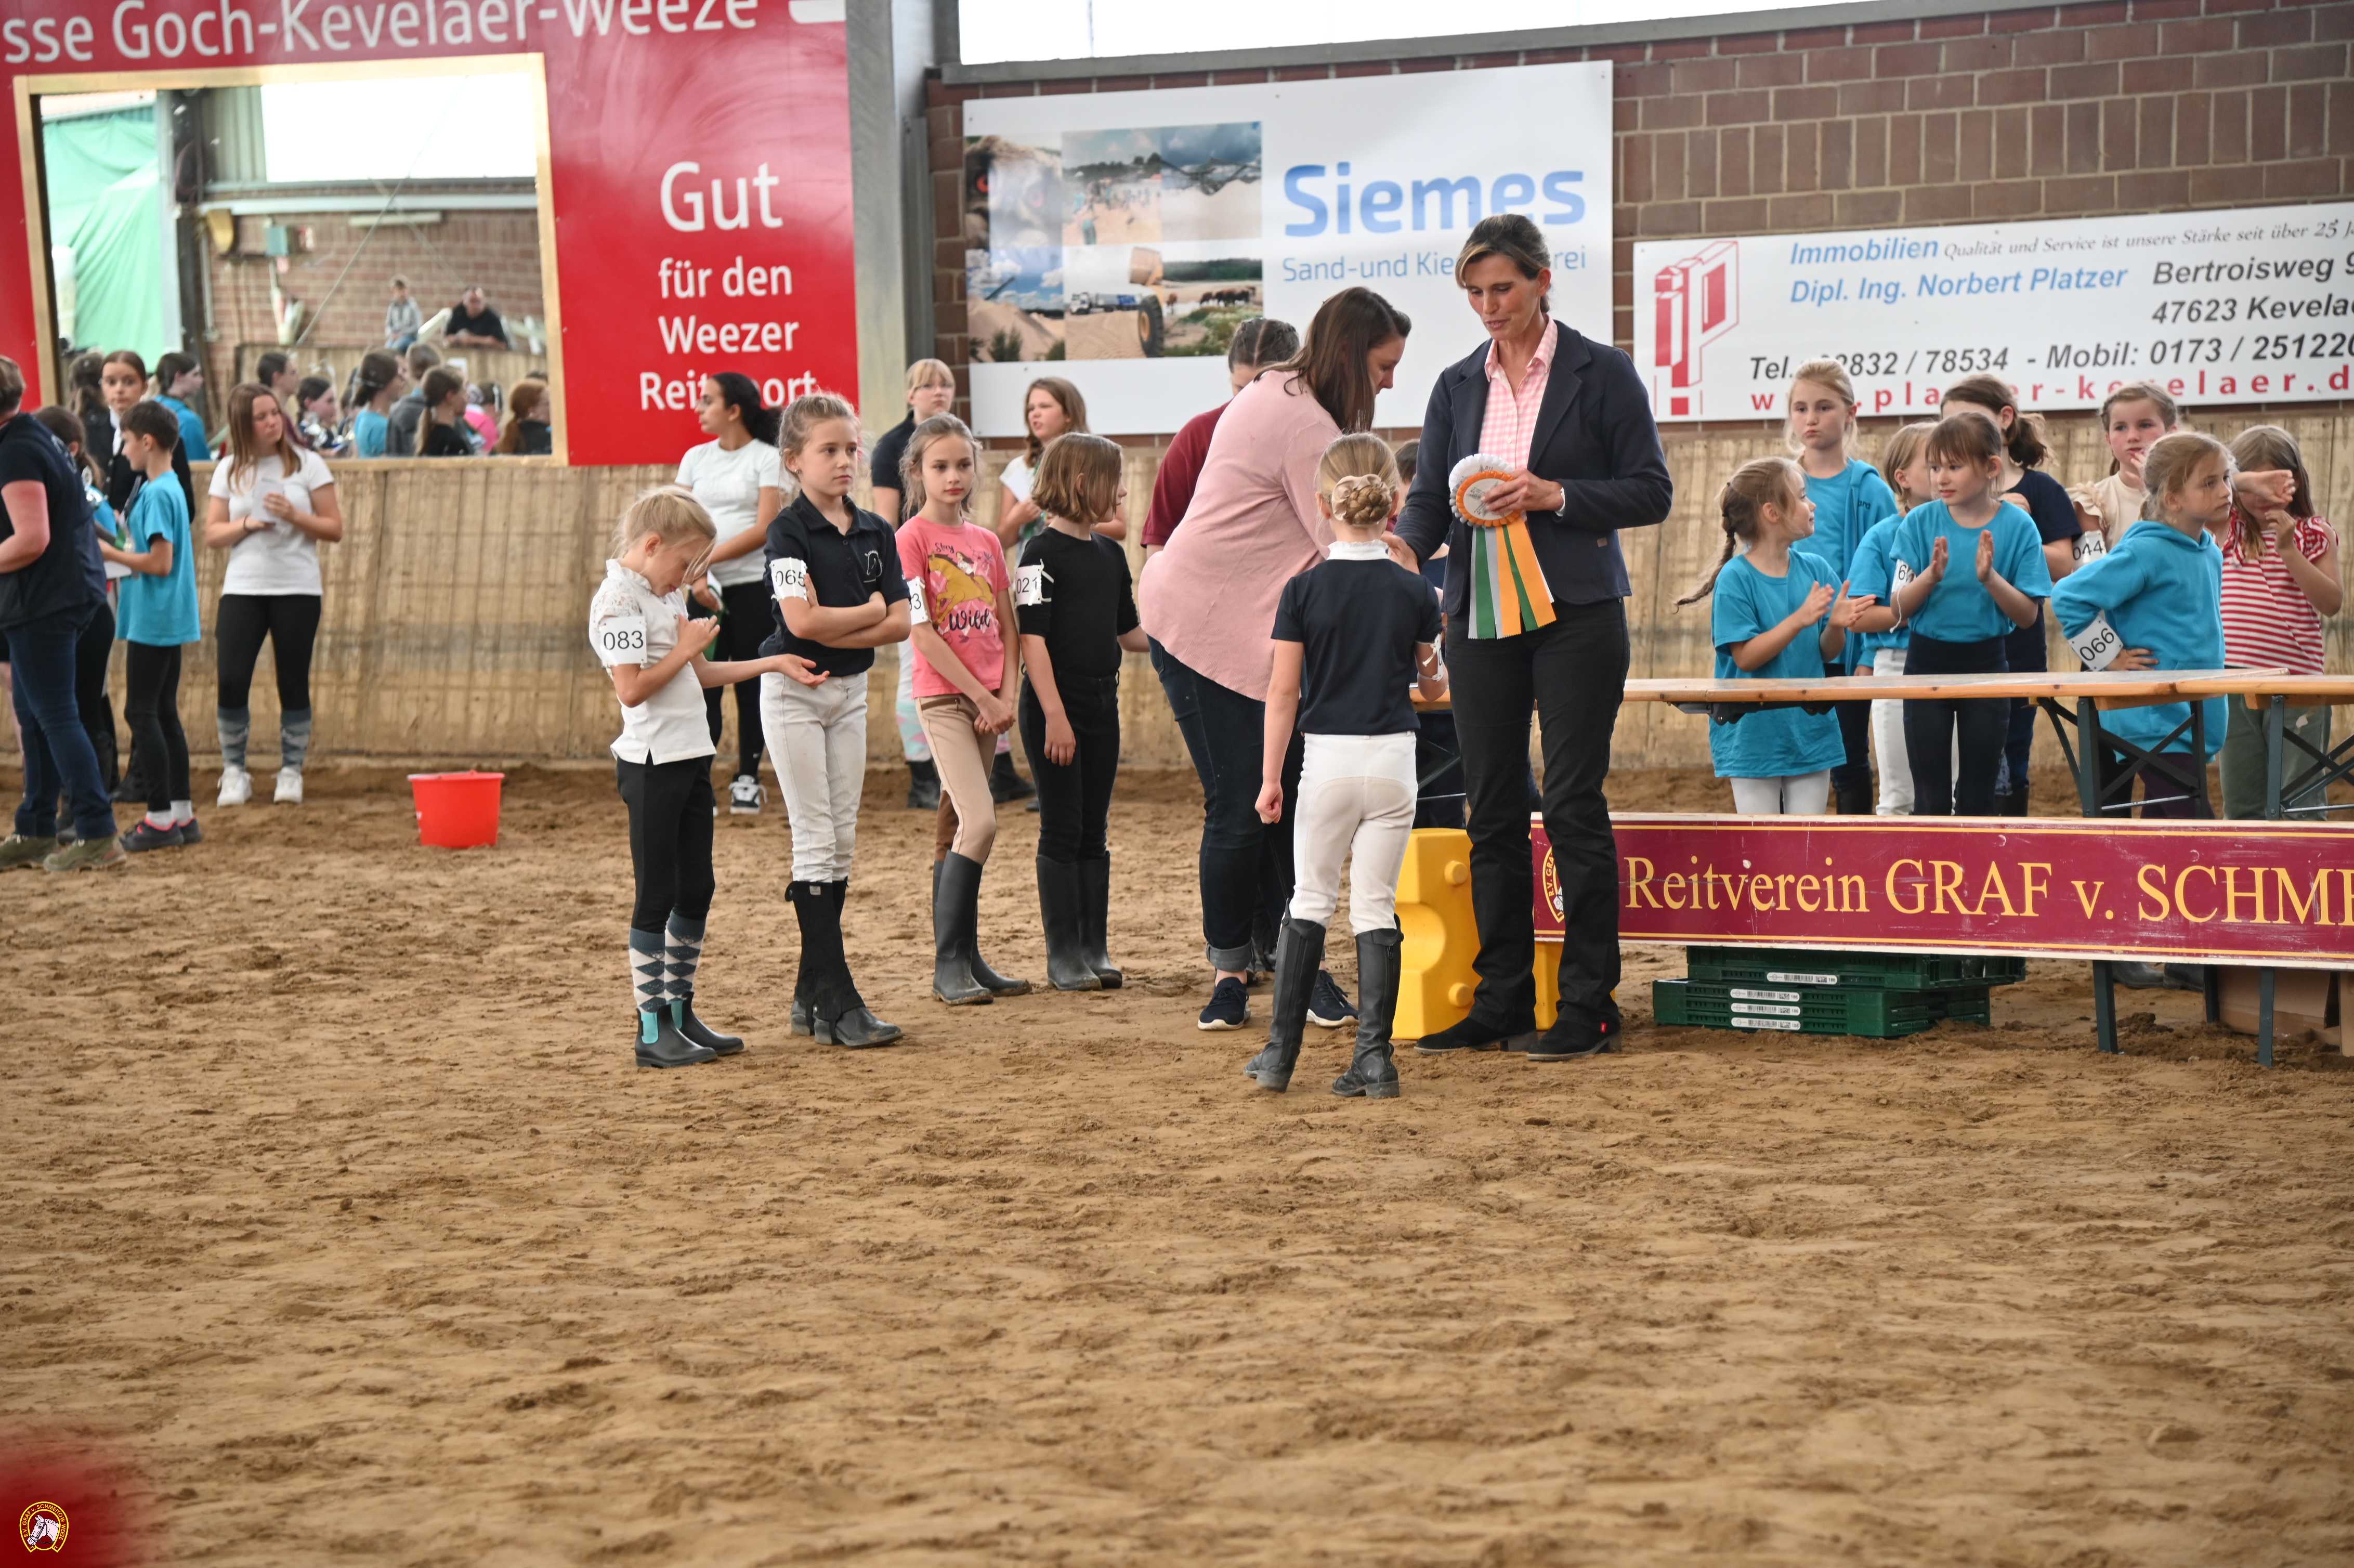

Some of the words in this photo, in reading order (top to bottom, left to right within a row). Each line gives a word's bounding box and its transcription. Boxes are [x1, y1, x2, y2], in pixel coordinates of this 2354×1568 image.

[112, 0, 757, 59] Goch-Kevelaer-Weeze
[660, 161, 783, 232] Gut
[1284, 161, 1586, 237] Siemes
[1790, 237, 1939, 264] Immobilien
[1944, 233, 2002, 258] Qualität
[2010, 239, 2038, 253] und
[2043, 237, 2096, 252] Service
[2102, 236, 2119, 248] ist
[2126, 234, 2176, 247] unsere
[2182, 226, 2231, 243] Stärke
[2237, 226, 2264, 241] seit
[2271, 222, 2309, 239] über
[2314, 218, 2339, 238] 25
[659, 257, 713, 299] für
[722, 256, 792, 297] den
[1283, 252, 1407, 282] Sand-und
[2153, 256, 2334, 284] Bertroisweg
[1790, 278, 1849, 307] Dipl.
[1858, 276, 1906, 304] Ing.
[1917, 270, 2022, 297] Norbert
[2030, 267, 2128, 291] Platzer
[2151, 298, 2237, 323] 47623
[2246, 293, 2354, 320] Kevela
[658, 315, 800, 354] Weezer
[1927, 347, 2008, 373] 78534
[2047, 341, 2139, 368] Mobil:
[2150, 338, 2222, 364] 0173
[640, 369, 817, 410] Reitort
[935, 542, 954, 553] Stay
[2073, 540, 2103, 560] 044
[949, 608, 990, 631] Wild
[603, 630, 644, 650] 083
[2080, 628, 2114, 661] 066
[1546, 853, 1554, 877] GRA
[1624, 855, 1871, 912] Reitverein
[1886, 858, 2052, 918] GRAF
[2071, 880, 2114, 920] v.
